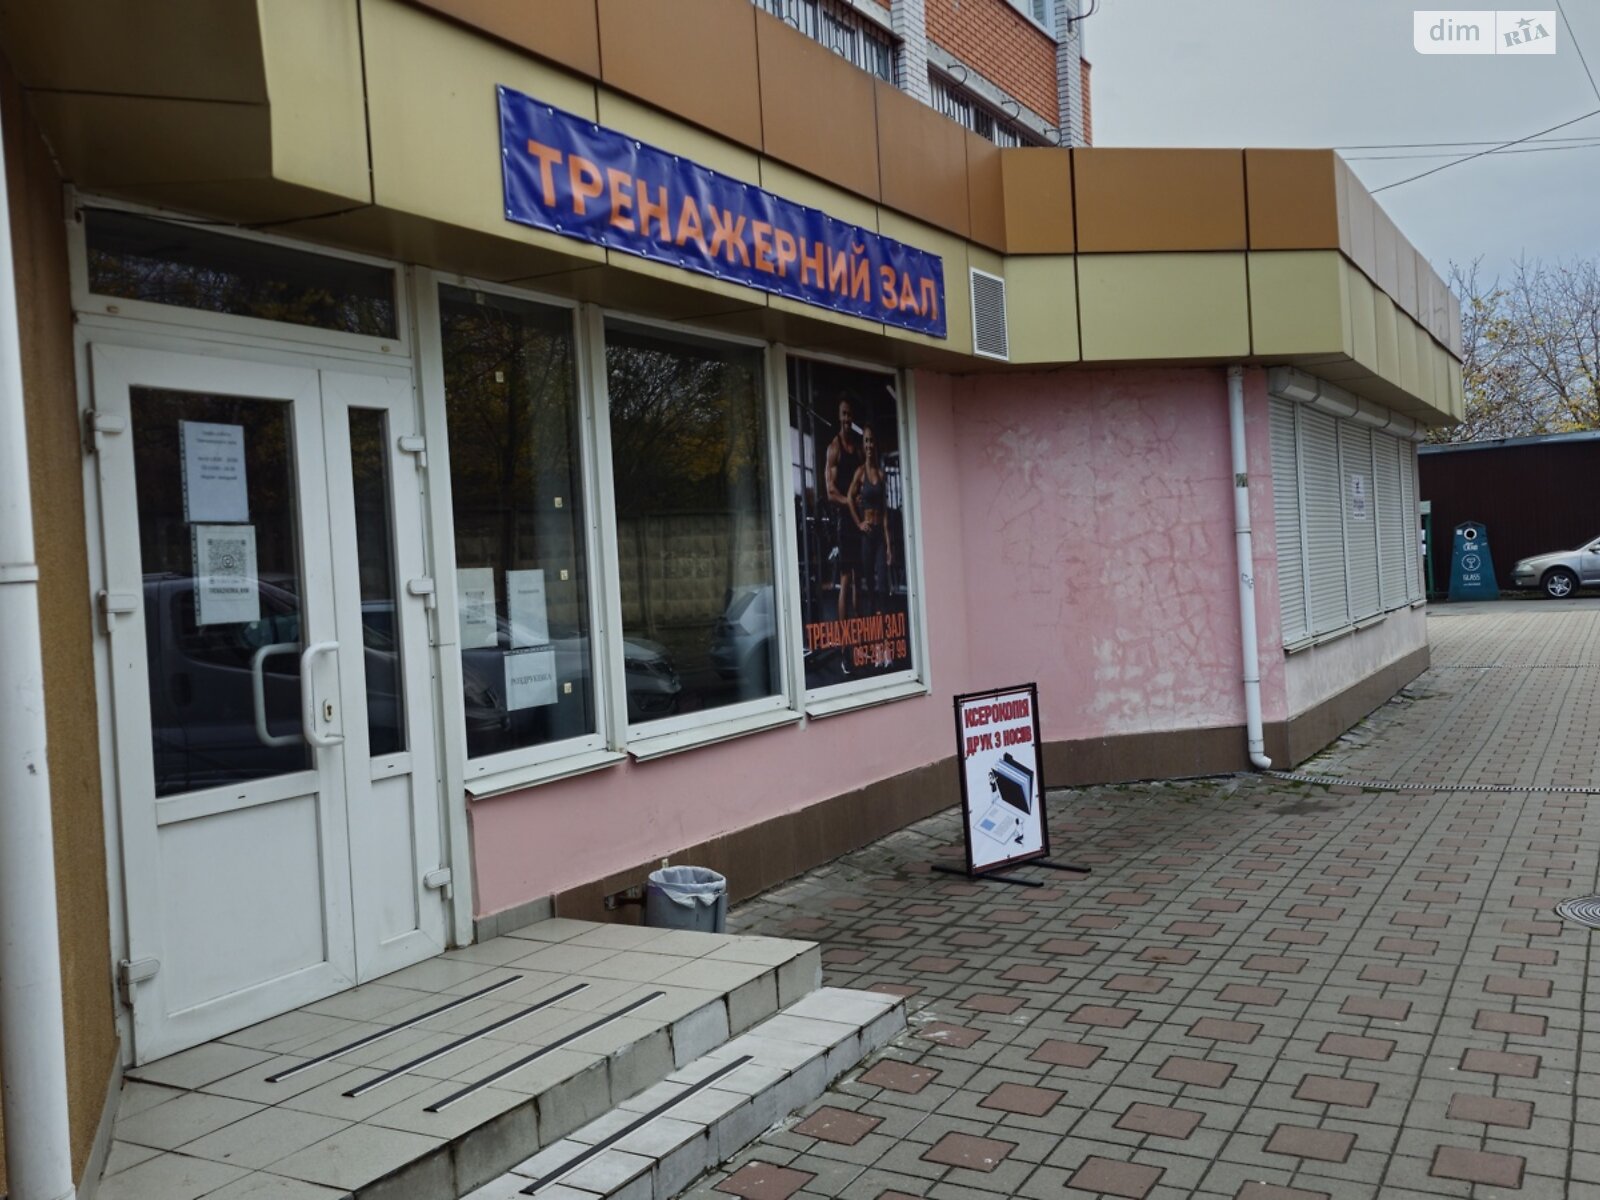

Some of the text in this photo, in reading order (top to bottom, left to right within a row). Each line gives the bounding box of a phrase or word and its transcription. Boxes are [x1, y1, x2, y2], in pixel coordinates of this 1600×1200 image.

[528, 138, 938, 321] ТРЕНАЖЕРНИЙ ЗАЛ
[1463, 573, 1481, 581] GLASS
[805, 611, 906, 651] ТРЕНАЖЕРНИЙ ЗАЛ
[964, 698, 1030, 729] КСЕРОКОПІЯ
[966, 732, 993, 757] ДРУК
